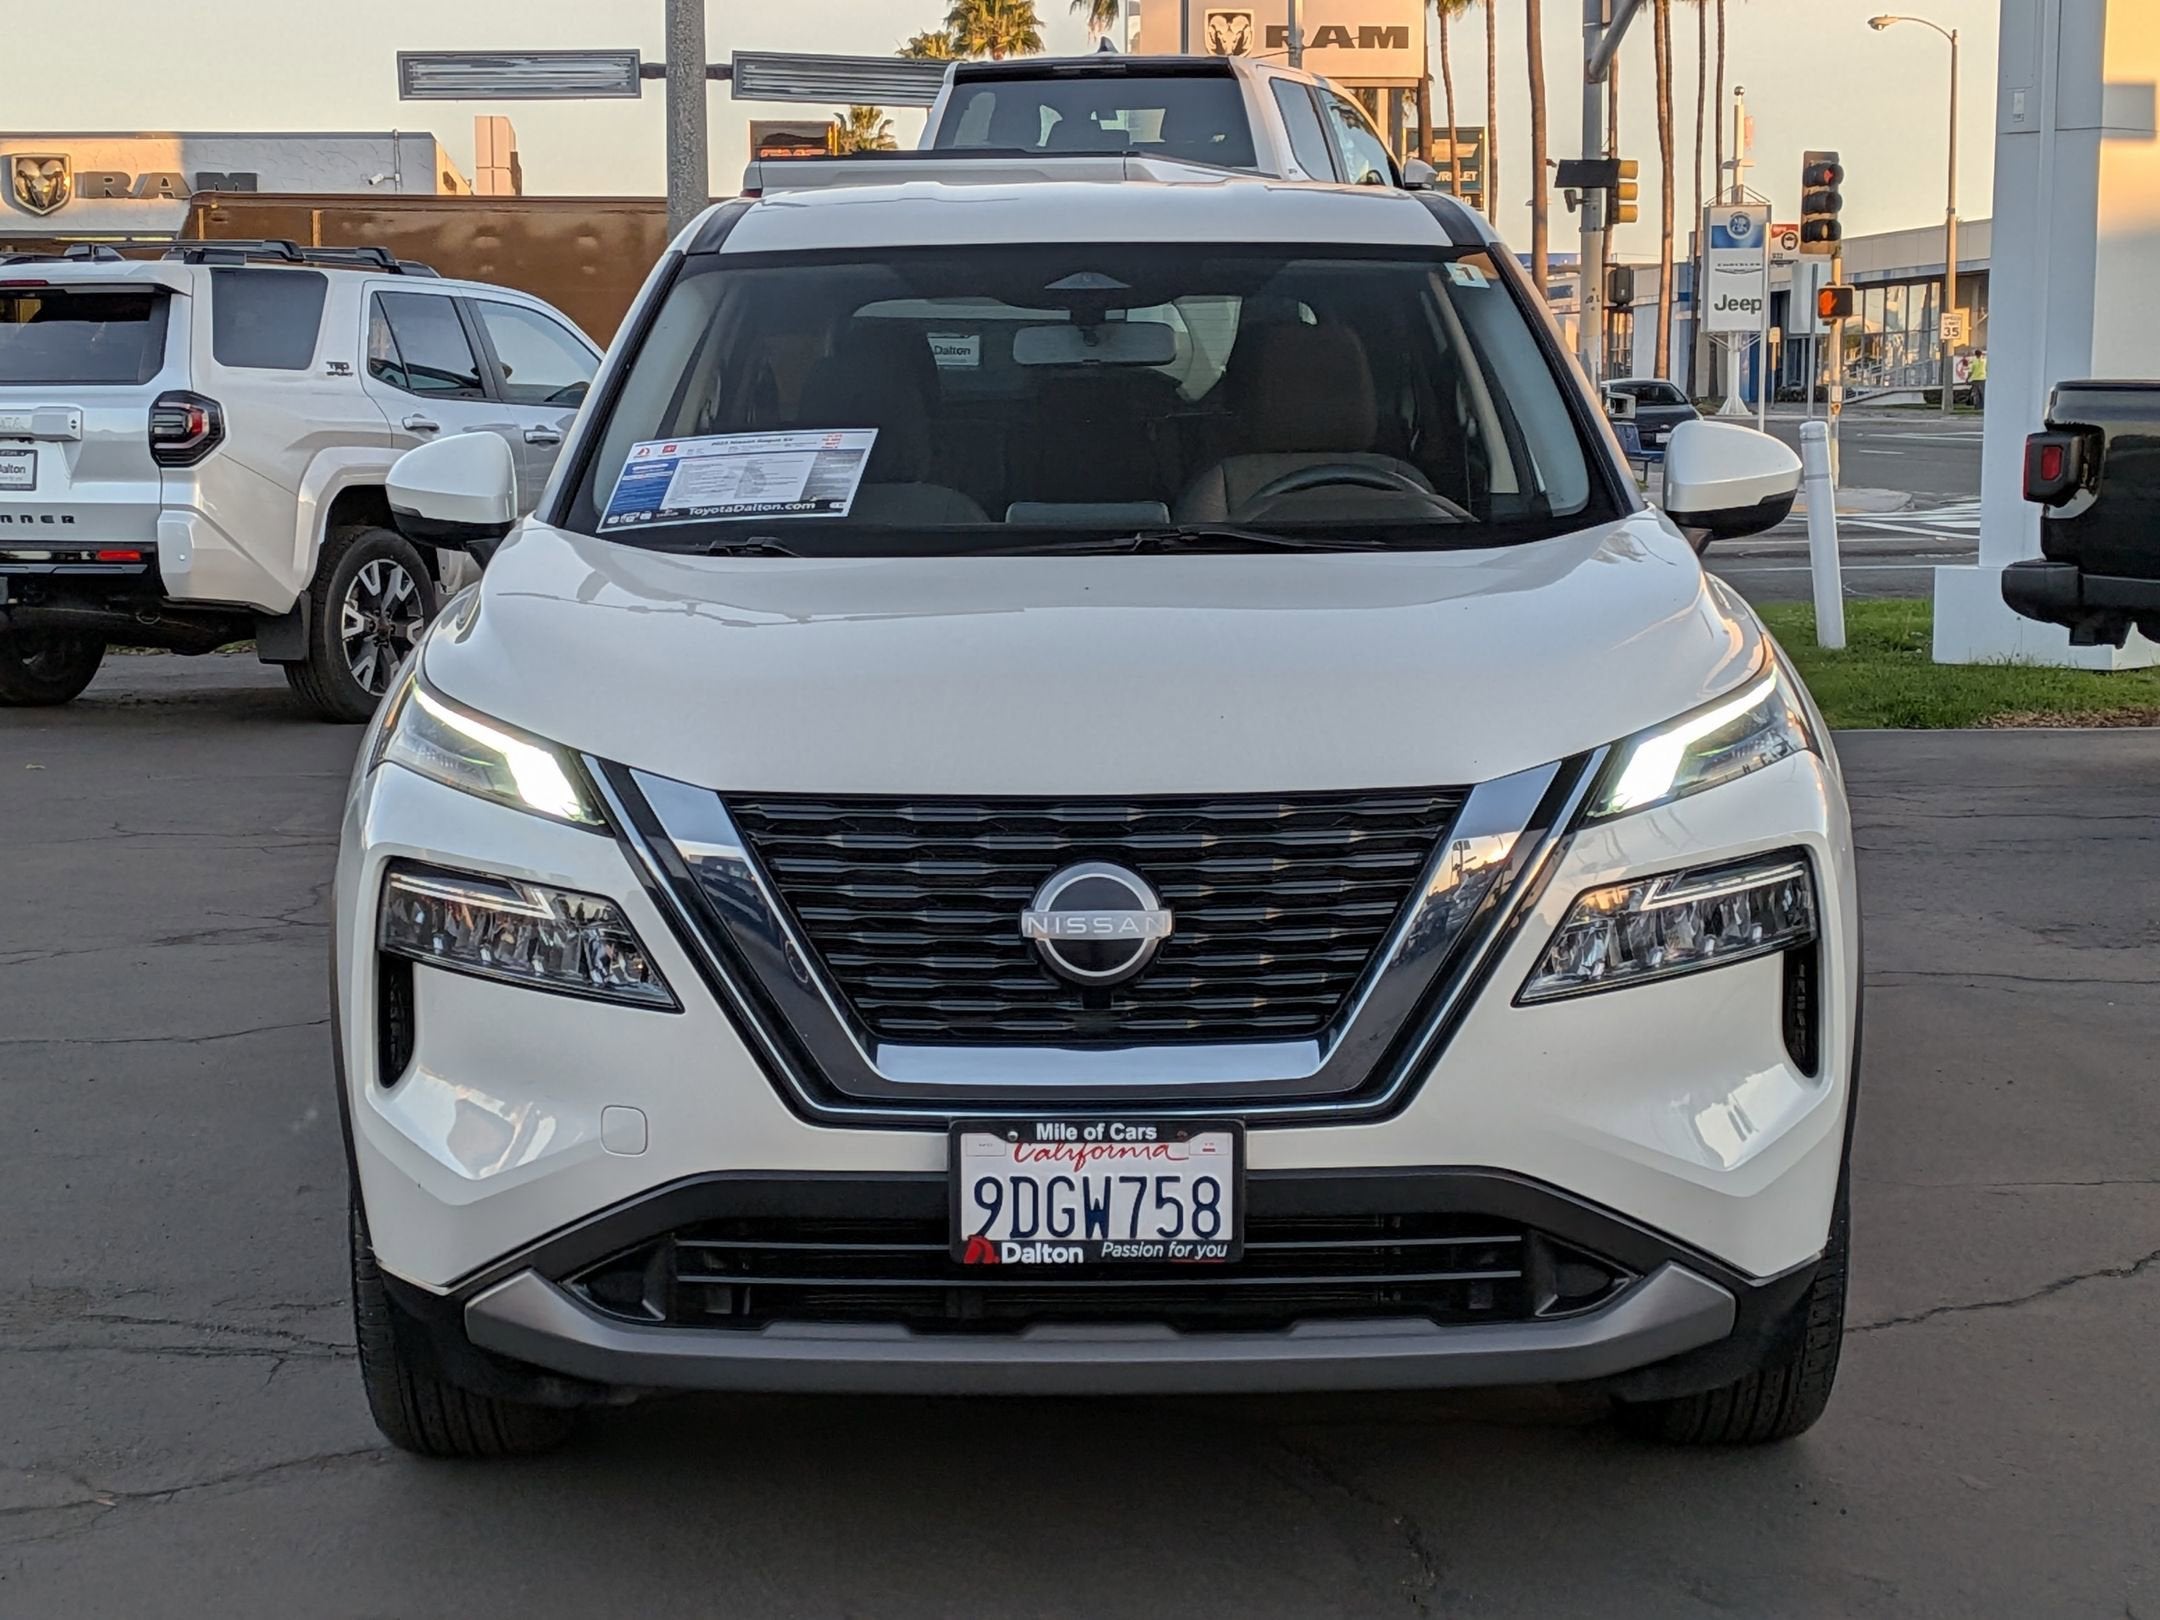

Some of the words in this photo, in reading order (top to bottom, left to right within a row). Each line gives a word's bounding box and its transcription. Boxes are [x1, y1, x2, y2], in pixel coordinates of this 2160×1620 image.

[1265, 25, 1409, 49] RAM
[74, 172, 257, 199] RAM
[1713, 293, 1762, 315] Jeep
[1943, 326, 1960, 337] 35
[934, 345, 971, 356] Dalton
[688, 499, 815, 516] ToyotaDalton.com
[1027, 916, 1167, 935] NISSAN
[1036, 1122, 1079, 1140] Mile
[1083, 1122, 1105, 1140] of
[1110, 1122, 1157, 1140] Cars
[1014, 1142, 1189, 1172] California
[973, 1175, 1222, 1240] 9DGW758
[1001, 1242, 1084, 1264] Dalton
[1101, 1242, 1164, 1258] Passion
[1167, 1241, 1193, 1258] for
[1194, 1243, 1228, 1260] you
